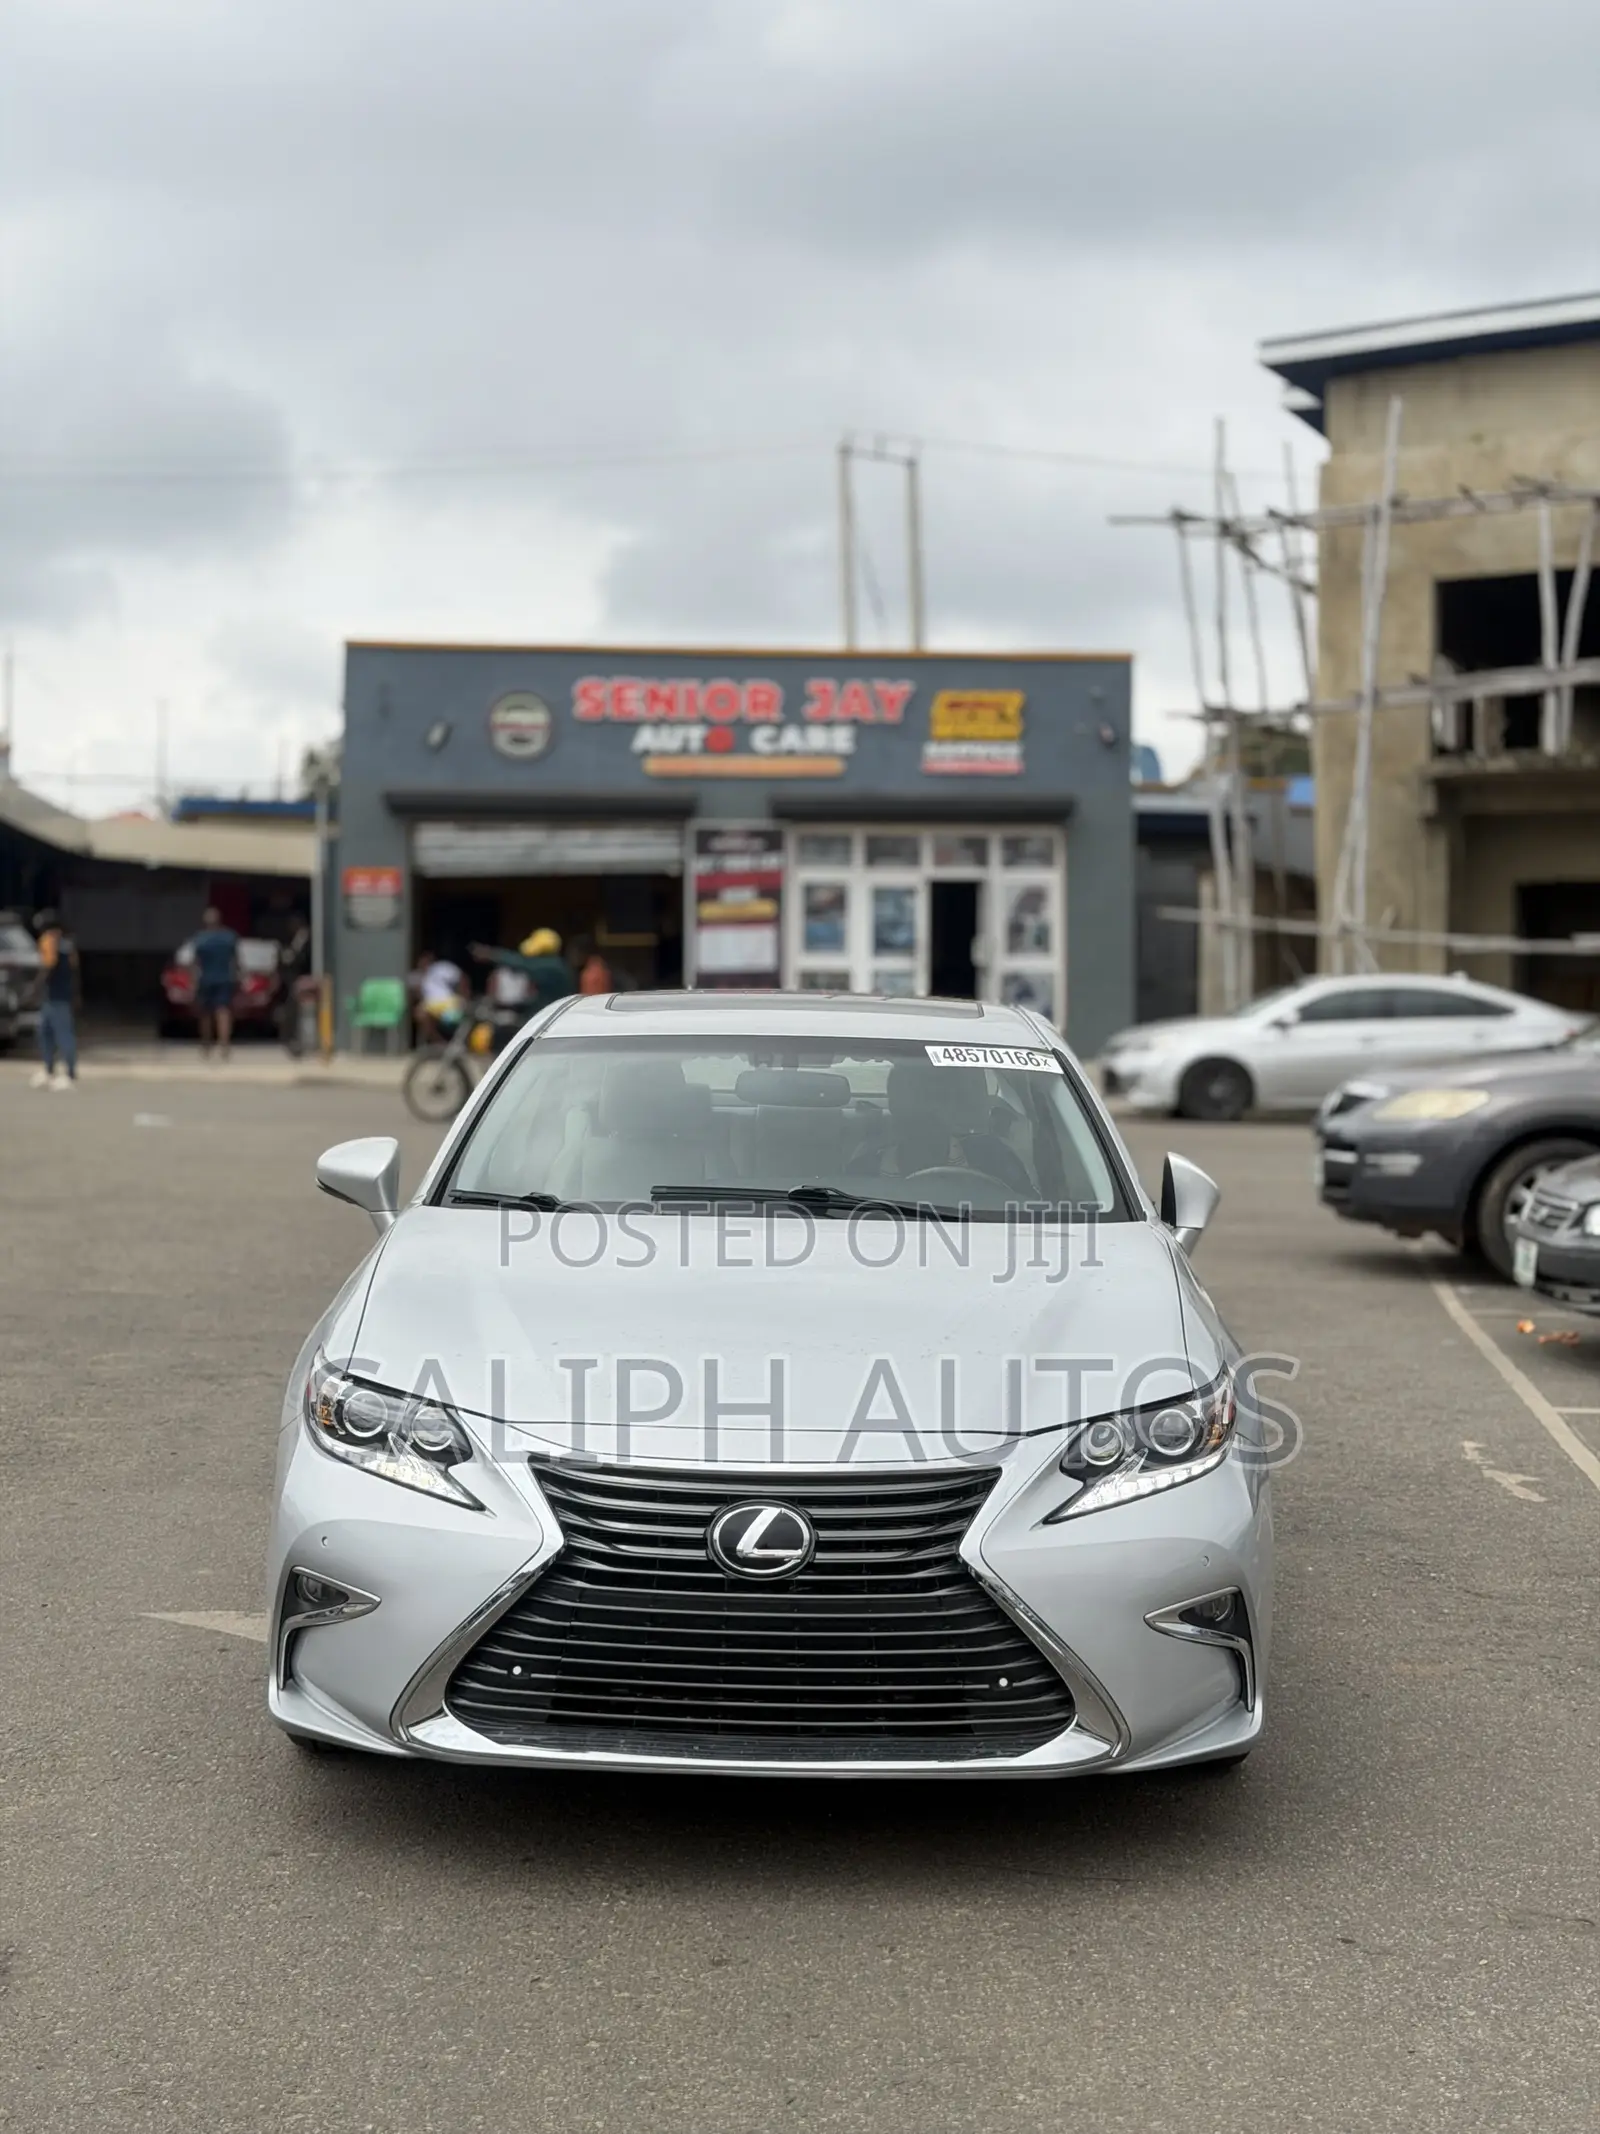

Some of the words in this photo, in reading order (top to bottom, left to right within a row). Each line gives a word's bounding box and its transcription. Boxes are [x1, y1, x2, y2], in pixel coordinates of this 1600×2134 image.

[572, 678, 785, 724] SENIOR
[802, 678, 914, 724] JAY
[630, 725, 735, 753] AUTO
